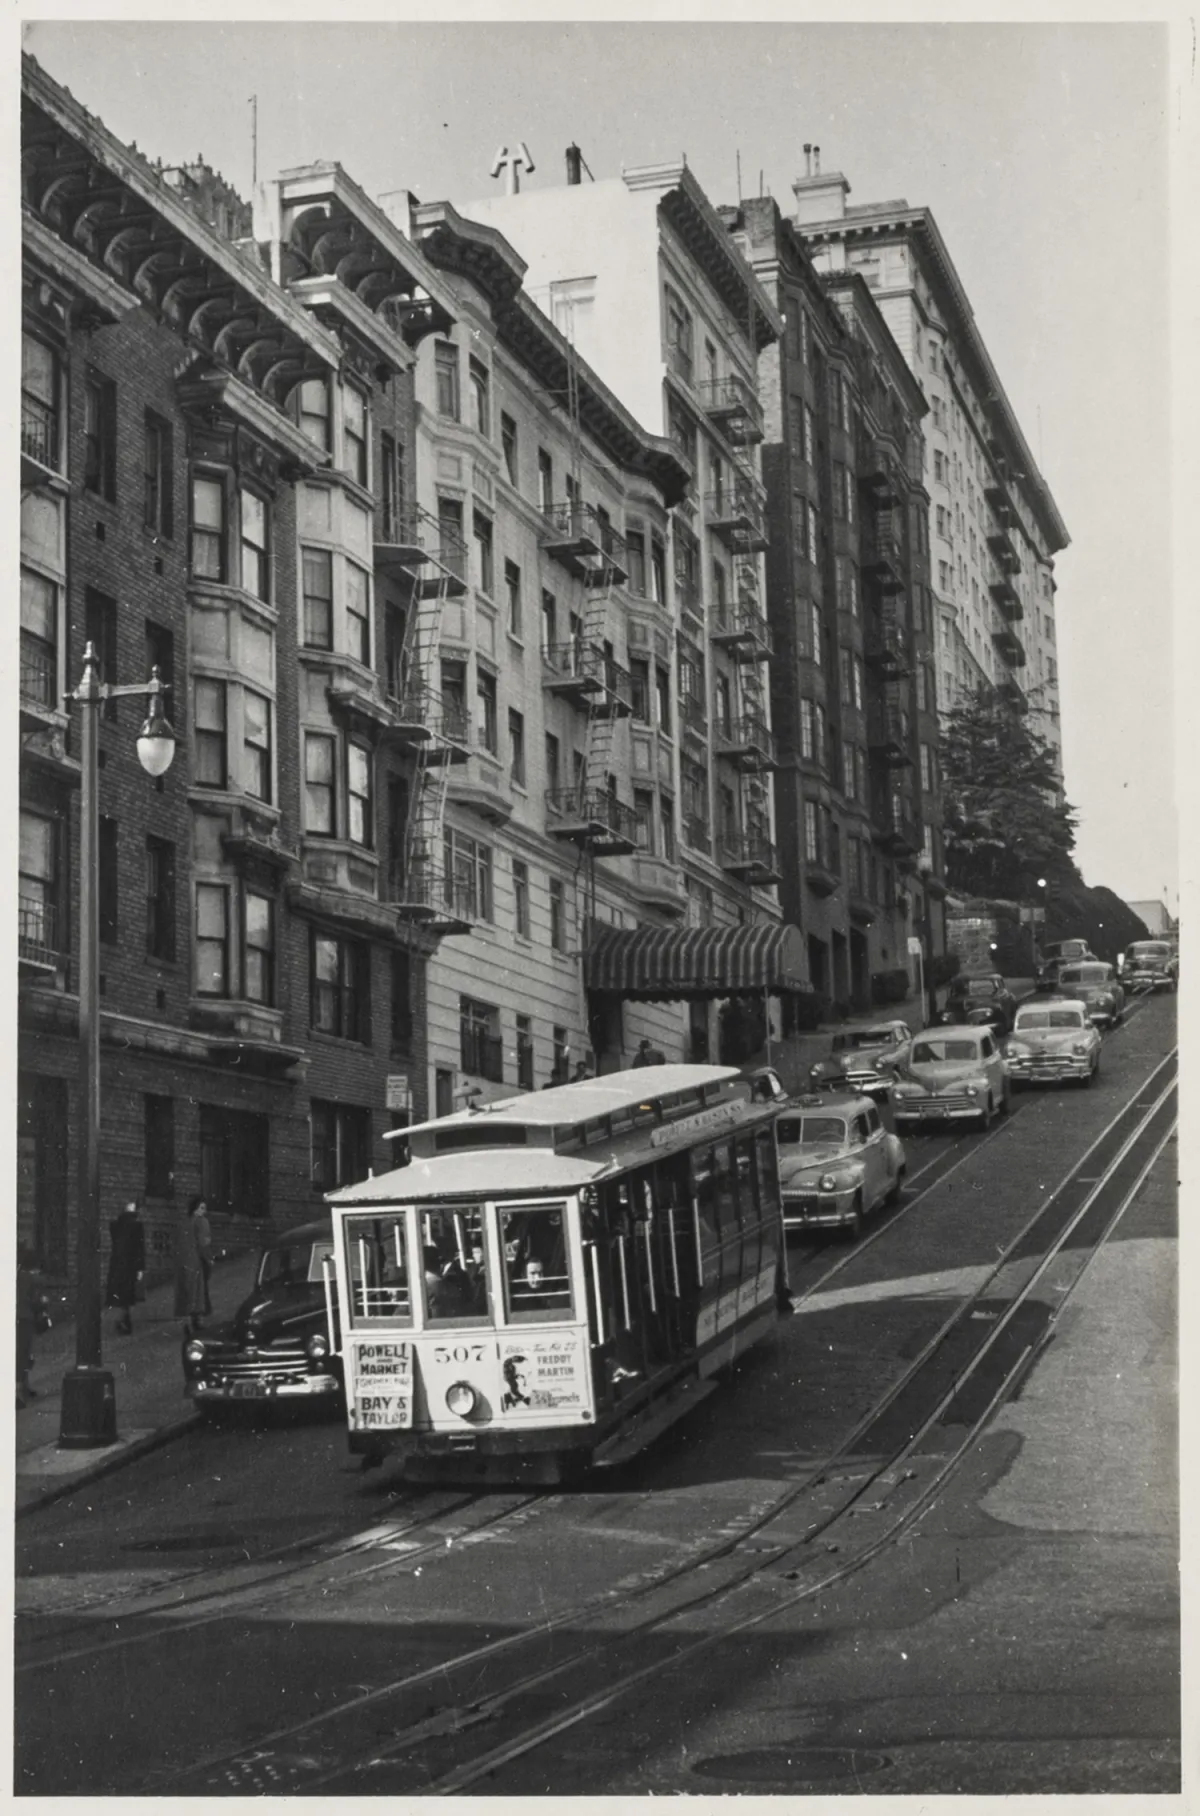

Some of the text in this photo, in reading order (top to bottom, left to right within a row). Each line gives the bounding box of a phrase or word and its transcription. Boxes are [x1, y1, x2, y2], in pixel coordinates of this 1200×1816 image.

[359, 1343, 409, 1361] POWELL
[434, 1344, 487, 1364] 507
[537, 1354, 572, 1365] FREDDY
[360, 1362, 408, 1376] MARKET
[537, 1366, 574, 1377] MARTIN
[361, 1396, 408, 1411] BAY &
[361, 1411, 408, 1426] TAYLOR
